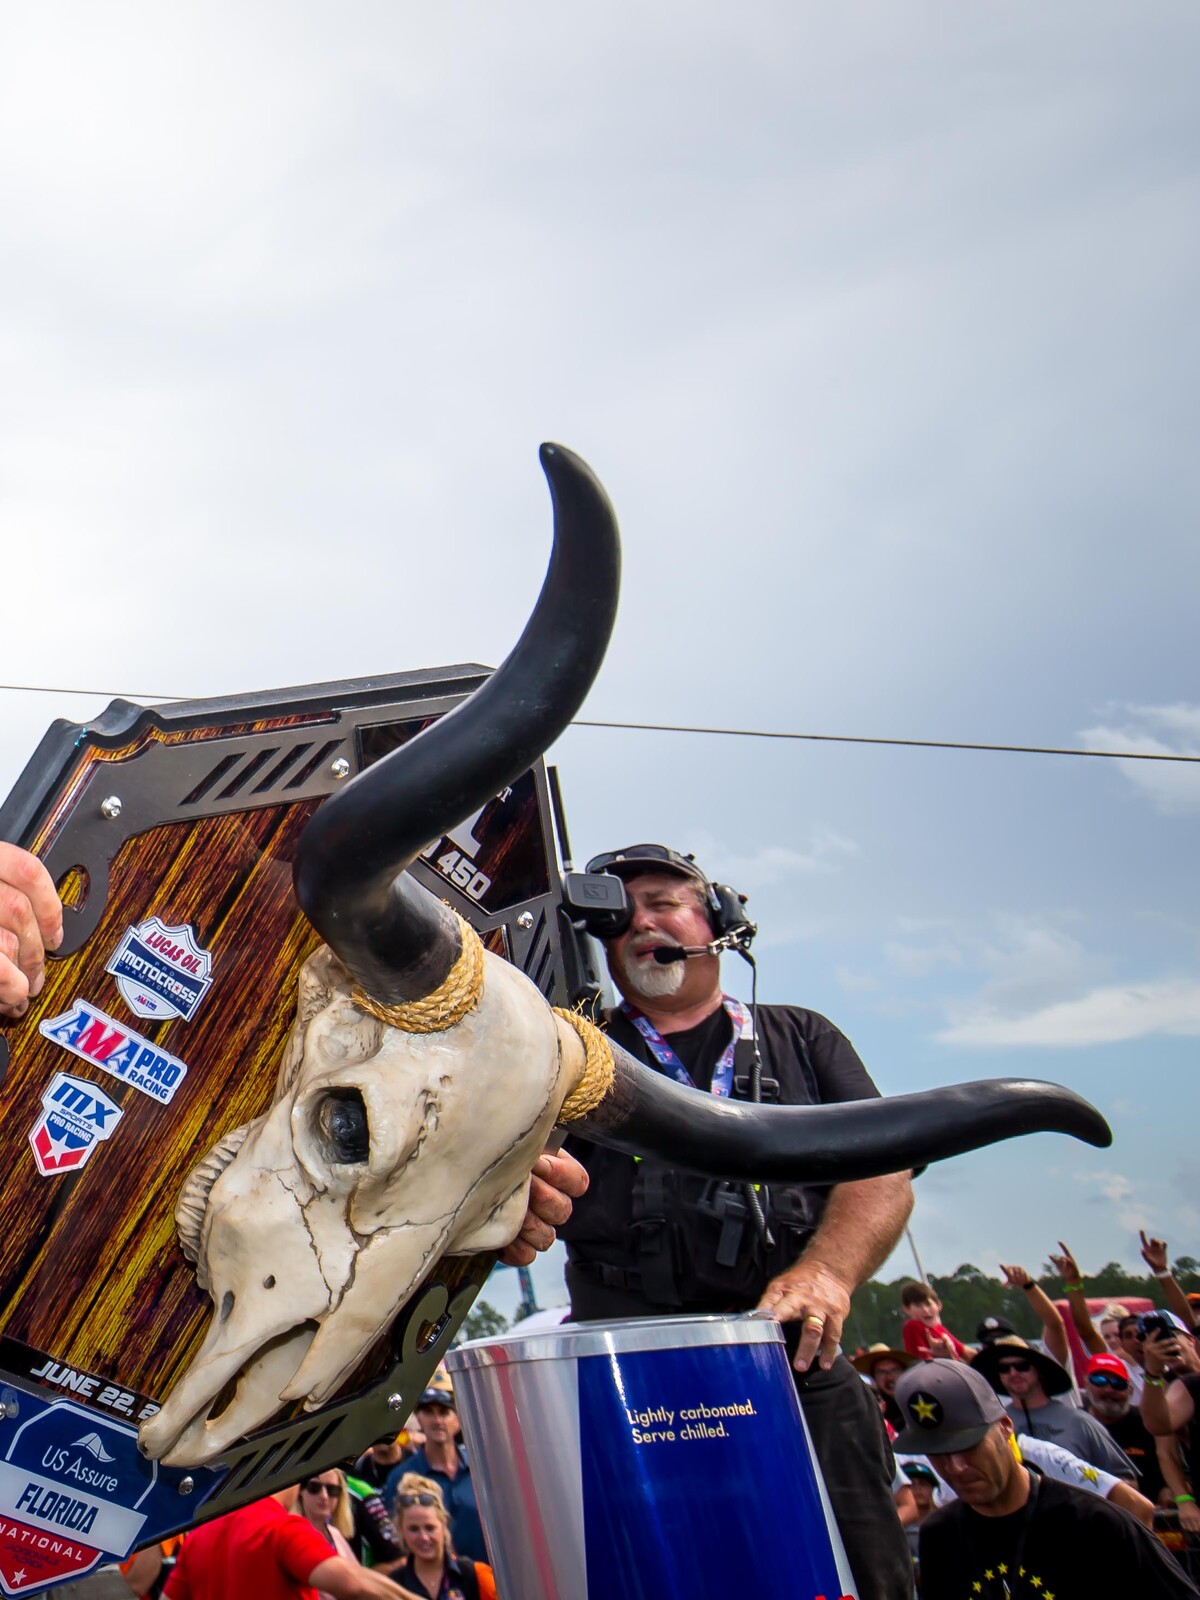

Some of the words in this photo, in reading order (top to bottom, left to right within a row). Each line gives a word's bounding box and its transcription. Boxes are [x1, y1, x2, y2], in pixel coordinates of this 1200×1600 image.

[437, 850, 492, 901] 450
[145, 930, 185, 962] LUCAS
[180, 954, 202, 974] OIL
[121, 949, 198, 1005] MOTOCROSS
[49, 1010, 141, 1076] AMA
[134, 1048, 182, 1088] PRO
[50, 1081, 118, 1130] MX
[127, 1069, 170, 1100] RACING
[49, 1113, 67, 1129] PRO
[63, 1120, 92, 1143] RACING
[59, 1108, 94, 1131] SPORTS
[29, 1360, 101, 1398] JUNE
[96, 1386, 135, 1417] 22,
[625, 1405, 675, 1428] Lightly
[680, 1398, 757, 1420] carbonated.
[631, 1427, 676, 1445] Serve
[680, 1421, 730, 1440] chilled.
[41, 1444, 68, 1472] US
[64, 1457, 119, 1492] Assure
[14, 1482, 100, 1535] FLORIDA
